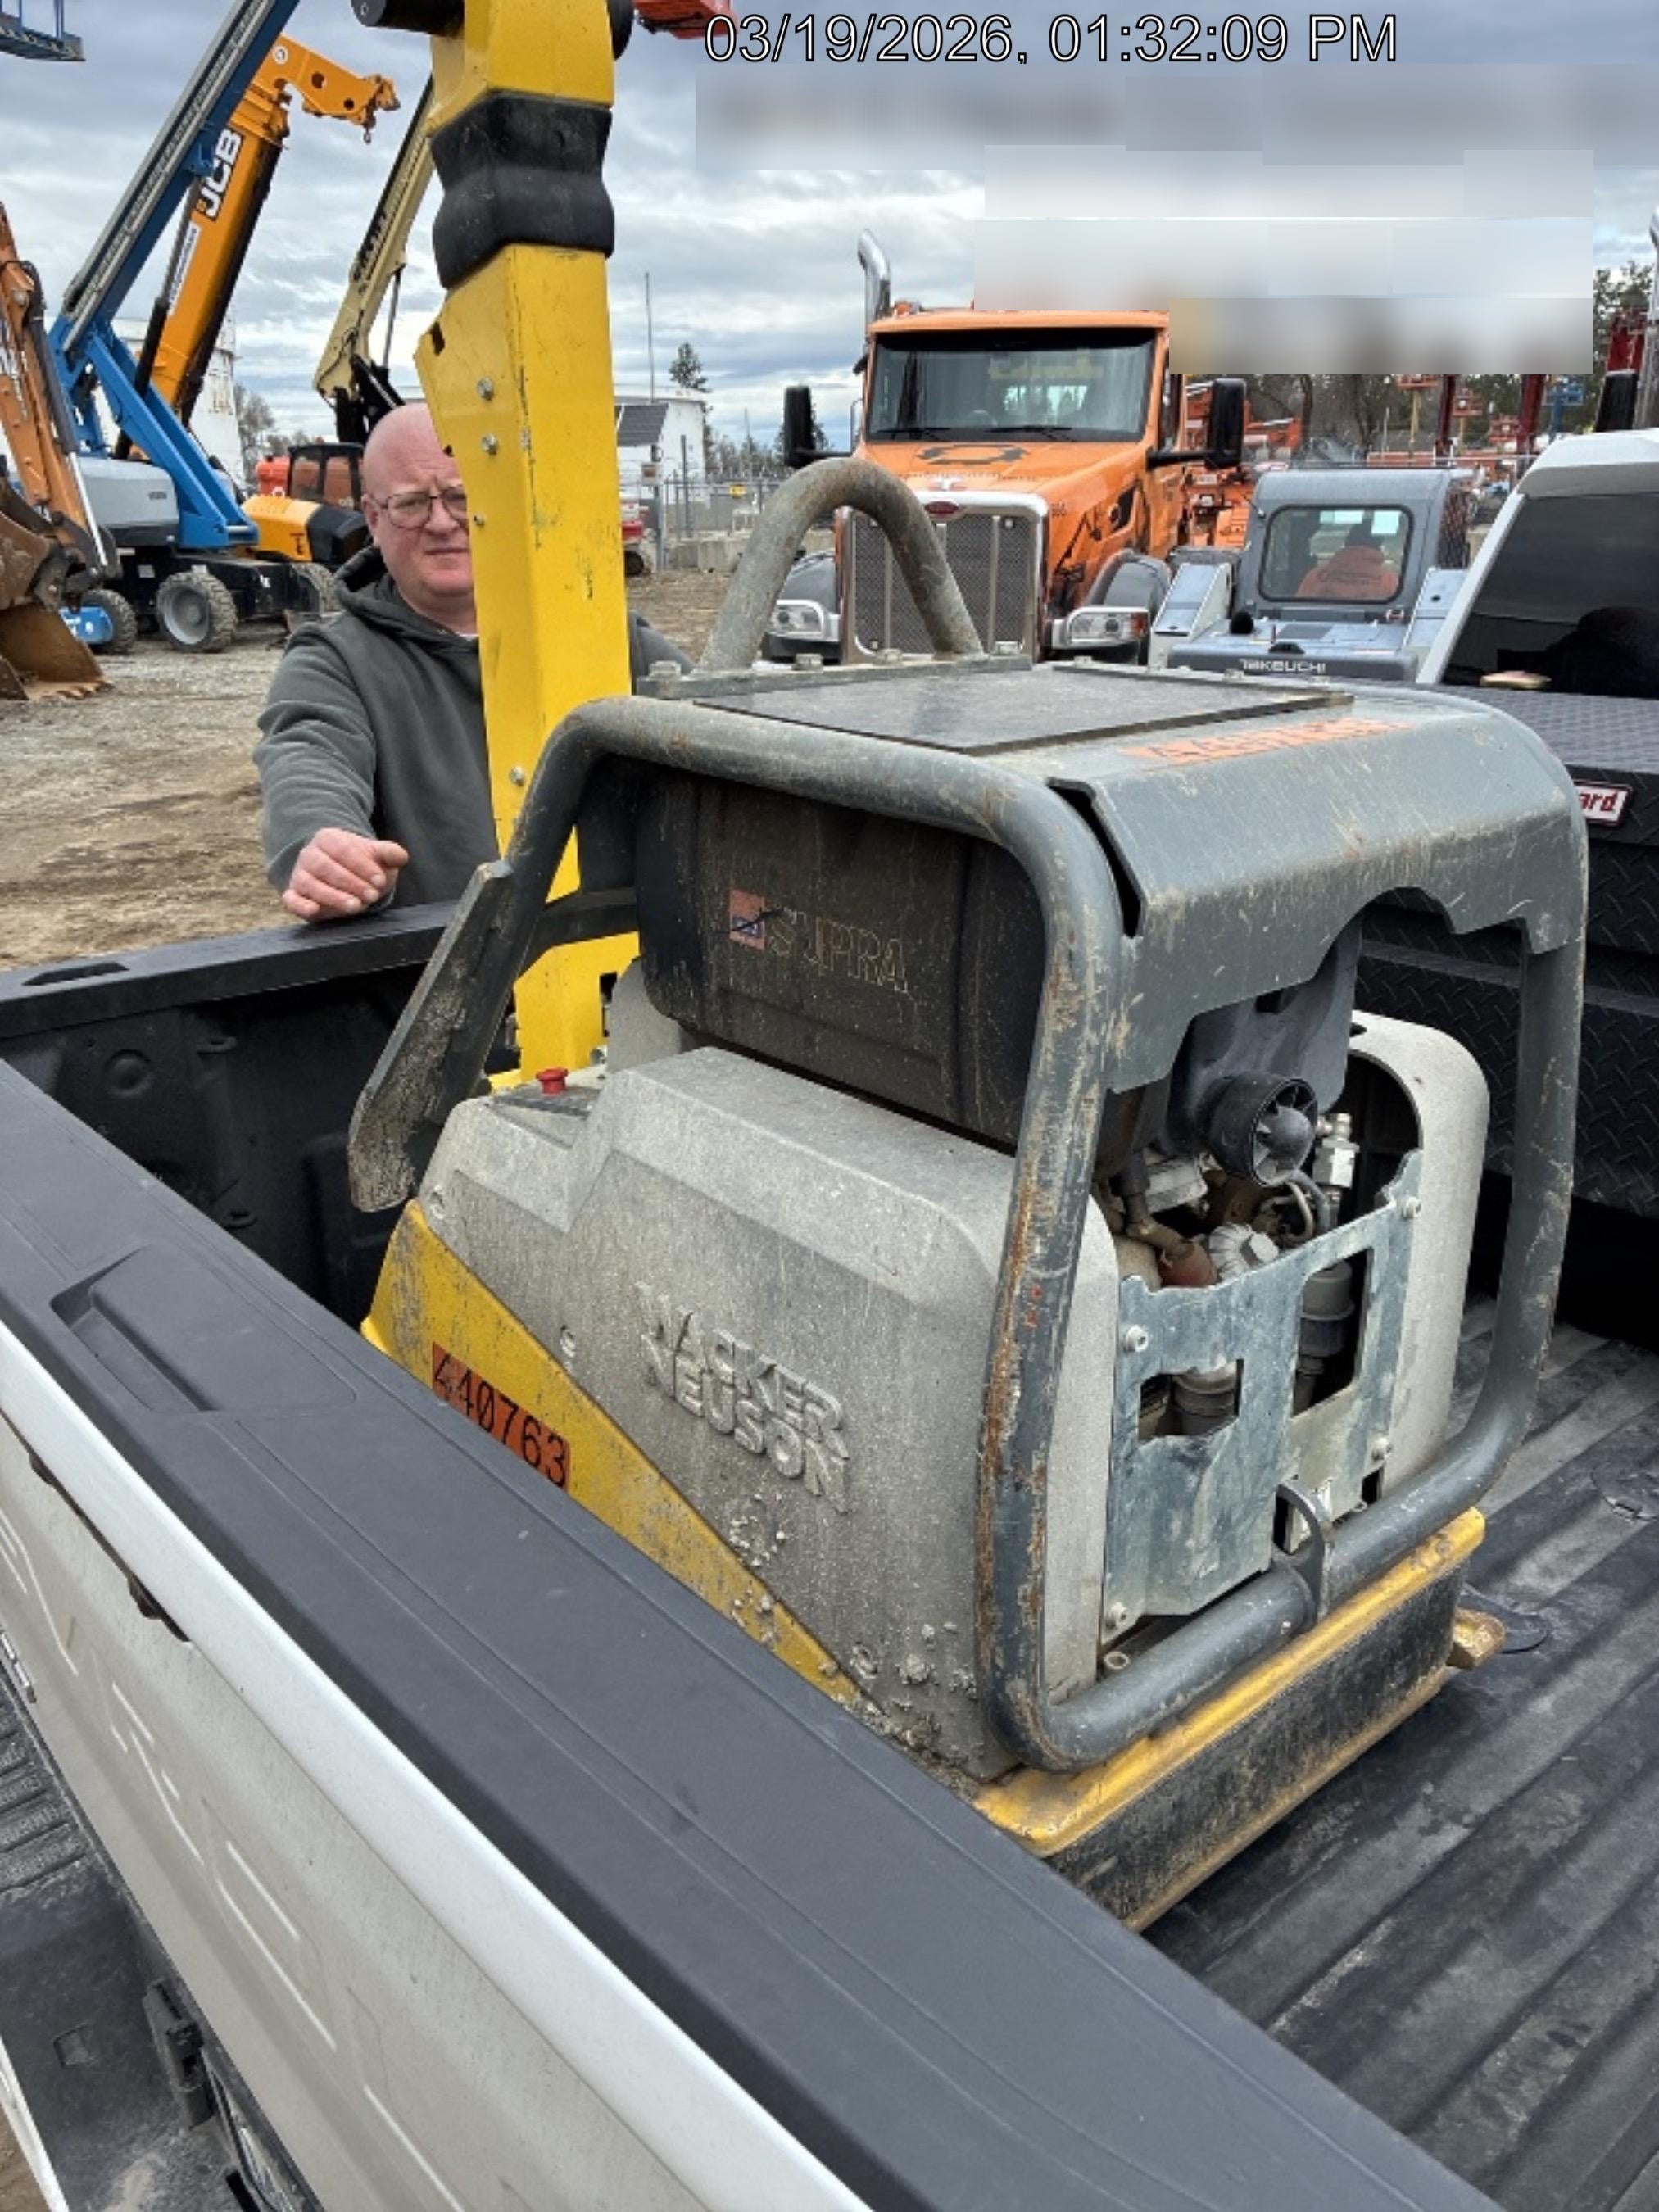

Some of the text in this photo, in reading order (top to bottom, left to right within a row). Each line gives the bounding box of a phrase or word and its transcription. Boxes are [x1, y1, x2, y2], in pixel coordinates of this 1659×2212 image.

[199, 127, 243, 220] JCB
[1238, 658, 1326, 674] TAKEUCHI
[434, 1353, 568, 1489] 440763
[636, 1280, 850, 1460] WACKER
[640, 1331, 850, 1515] NEUSON
